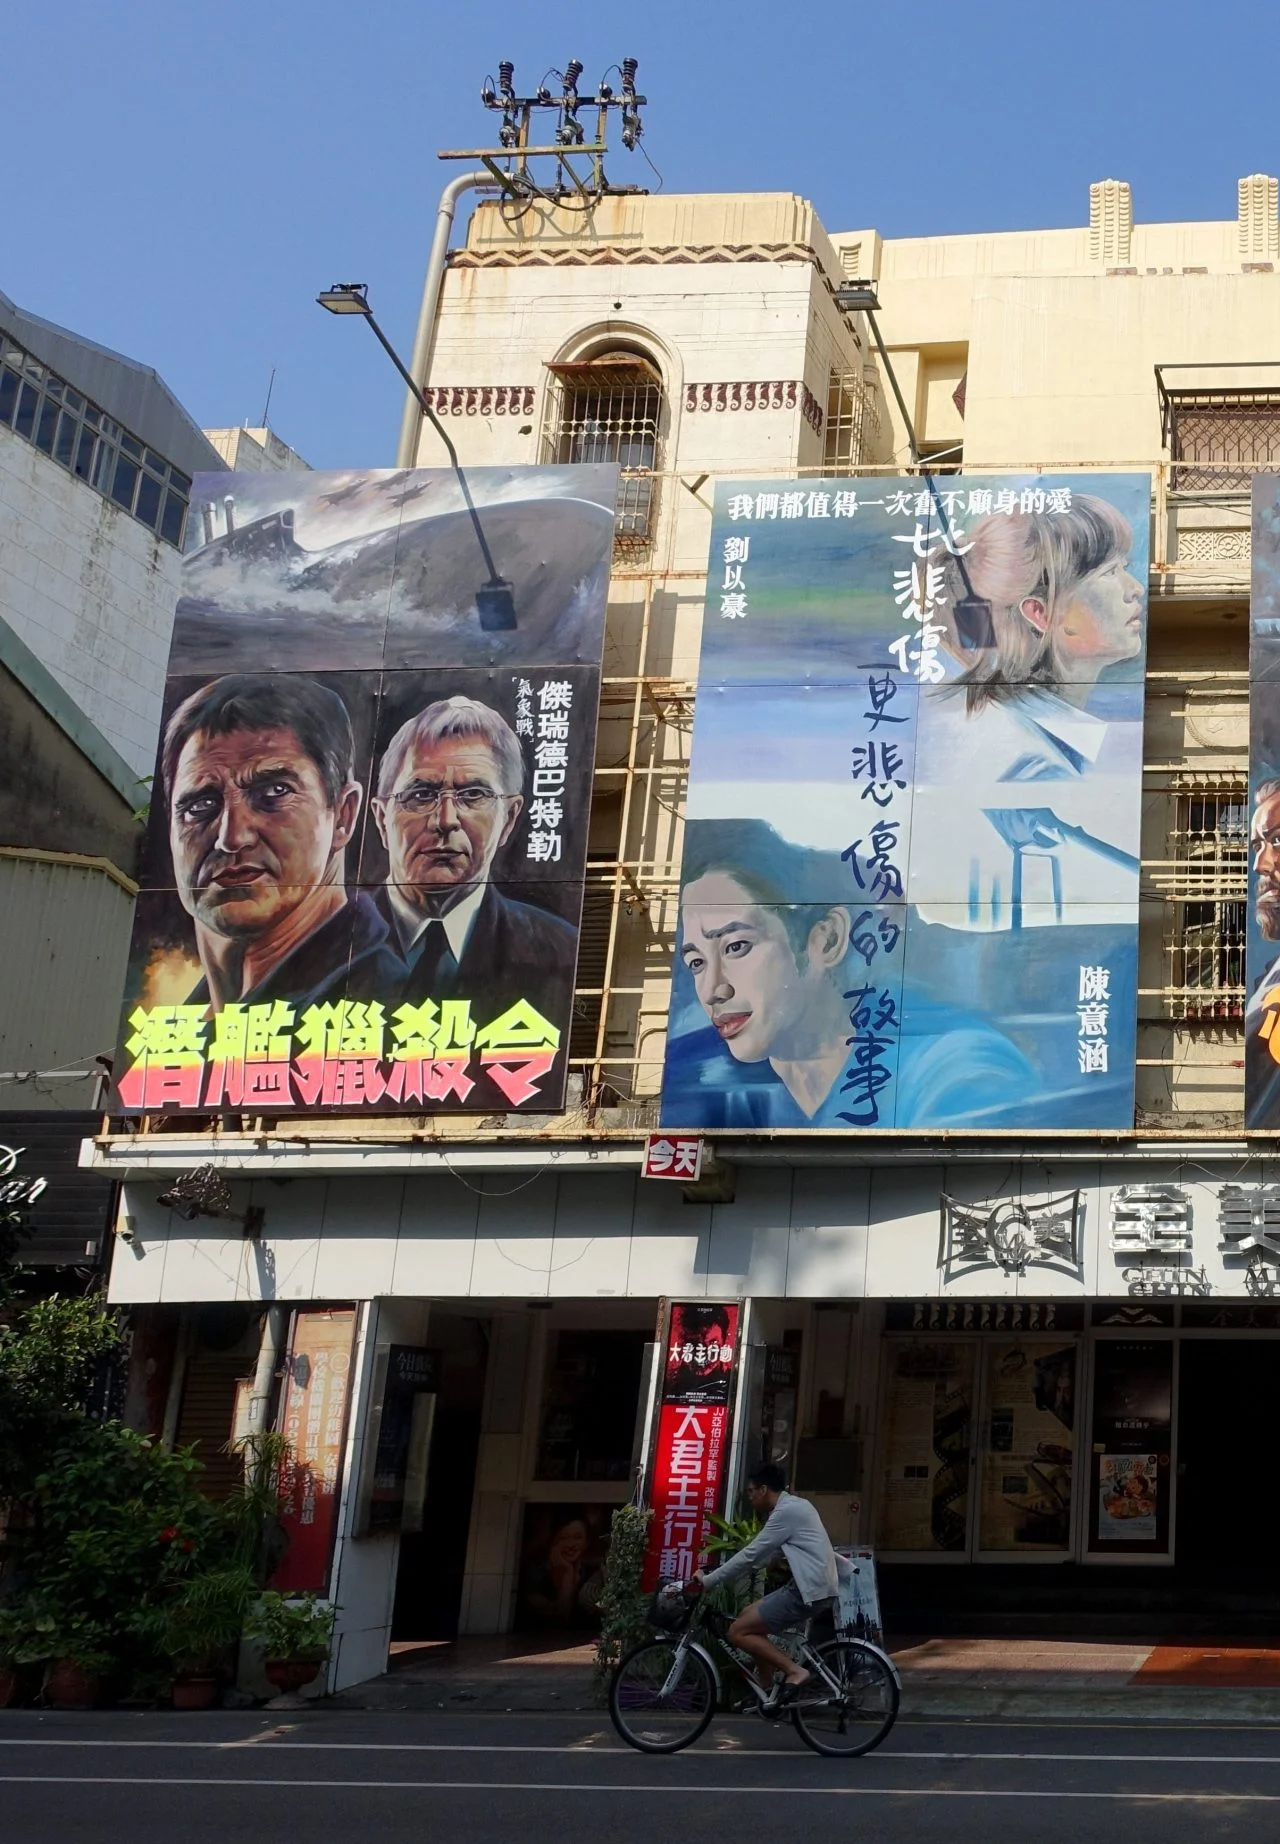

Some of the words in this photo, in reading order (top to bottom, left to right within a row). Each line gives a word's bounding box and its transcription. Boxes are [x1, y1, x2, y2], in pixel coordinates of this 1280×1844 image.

[719, 536, 751, 620] 劉以豪
[526, 680, 574, 863] 傑瑞德巴特勒
[118, 997, 563, 1108] 潛艦獵殺令
[1075, 963, 1110, 1073] 陳意涵
[650, 1139, 699, 1174] 今天
[1122, 1267, 1207, 1284] CHIN
[658, 1405, 708, 1582] 大君主行動
